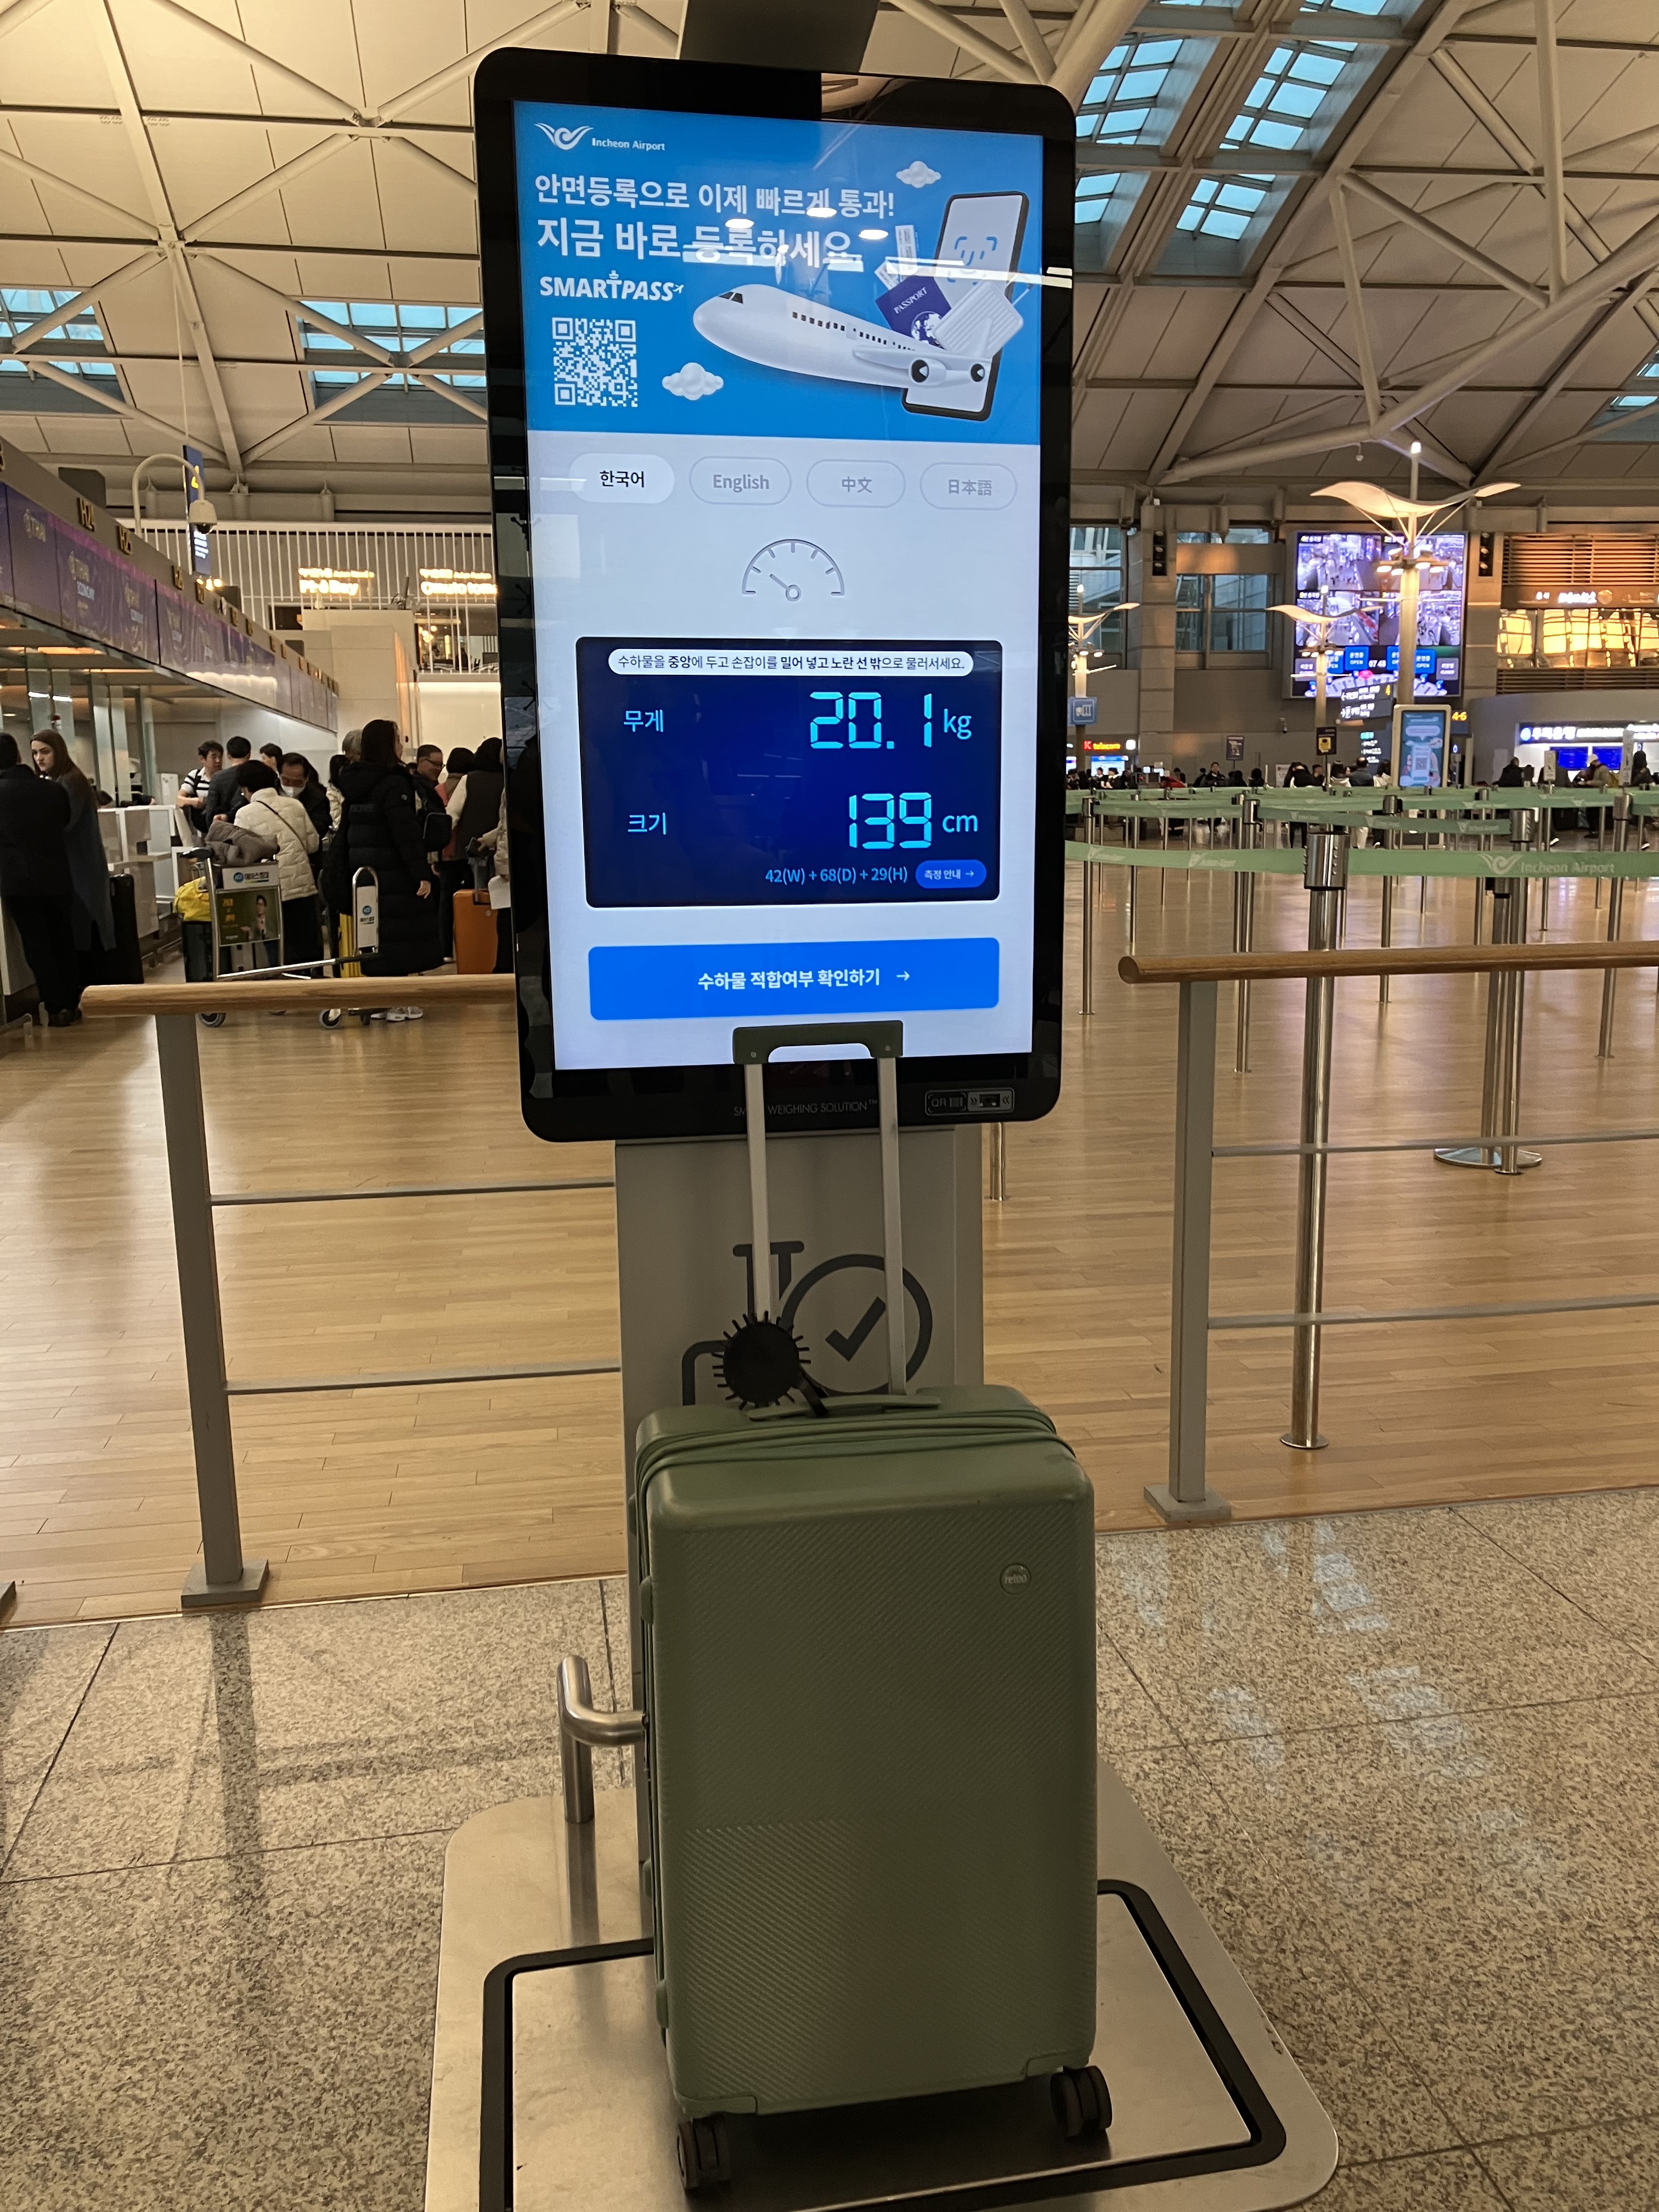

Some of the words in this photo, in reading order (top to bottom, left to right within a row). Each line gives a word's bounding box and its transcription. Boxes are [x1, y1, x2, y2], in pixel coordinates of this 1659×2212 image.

[591, 138, 630, 149] Incheon
[632, 140, 665, 151] Airport
[535, 174, 690, 208] 안면등록으로
[698, 184, 747, 215] 이제
[756, 187, 830, 217] 빠르게
[838, 189, 894, 219] 통과!
[537, 217, 603, 257] 지금
[616, 221, 681, 259] 바로
[540, 276, 674, 302] SMARTPASS
[893, 287, 928, 314] PASSPORT
[599, 470, 645, 488] 한국어
[713, 474, 770, 493] English
[842, 476, 872, 493] 中文
[948, 479, 992, 496] 日本語
[618, 655, 665, 669] 수하물을
[668, 655, 703, 669] 중앙에
[706, 656, 730, 669] 두고
[731, 656, 777, 669] 손잡이를
[780, 656, 803, 669] 밀어
[806, 656, 828, 670] 넣고
[831, 656, 854, 670] 노란
[856, 656, 867, 670] 선
[870, 656, 904, 670] 밖으로
[906, 657, 965, 670] 물러서세요.
[623, 709, 664, 732] 무게
[810, 691, 933, 750] 20.1
[943, 708, 972, 740] kg
[628, 812, 667, 835] 크기
[849, 792, 932, 850] 139
[942, 814, 978, 833] cm
[765, 867, 805, 885] 42(W)
[808, 871, 817, 880] +
[820, 867, 856, 885] 68(D)
[860, 870, 868, 879] +
[871, 866, 908, 884] 29(H)
[943, 868, 961, 879] 안내
[1520, 861, 1568, 874] Incheon
[1571, 861, 1615, 874] Airport
[698, 972, 747, 991] 수하물
[750, 969, 814, 989] 적합여부
[817, 968, 880, 987] 확인하기
[768, 1103, 817, 1115] WEIGHING
[931, 1098, 947, 1107] QR
